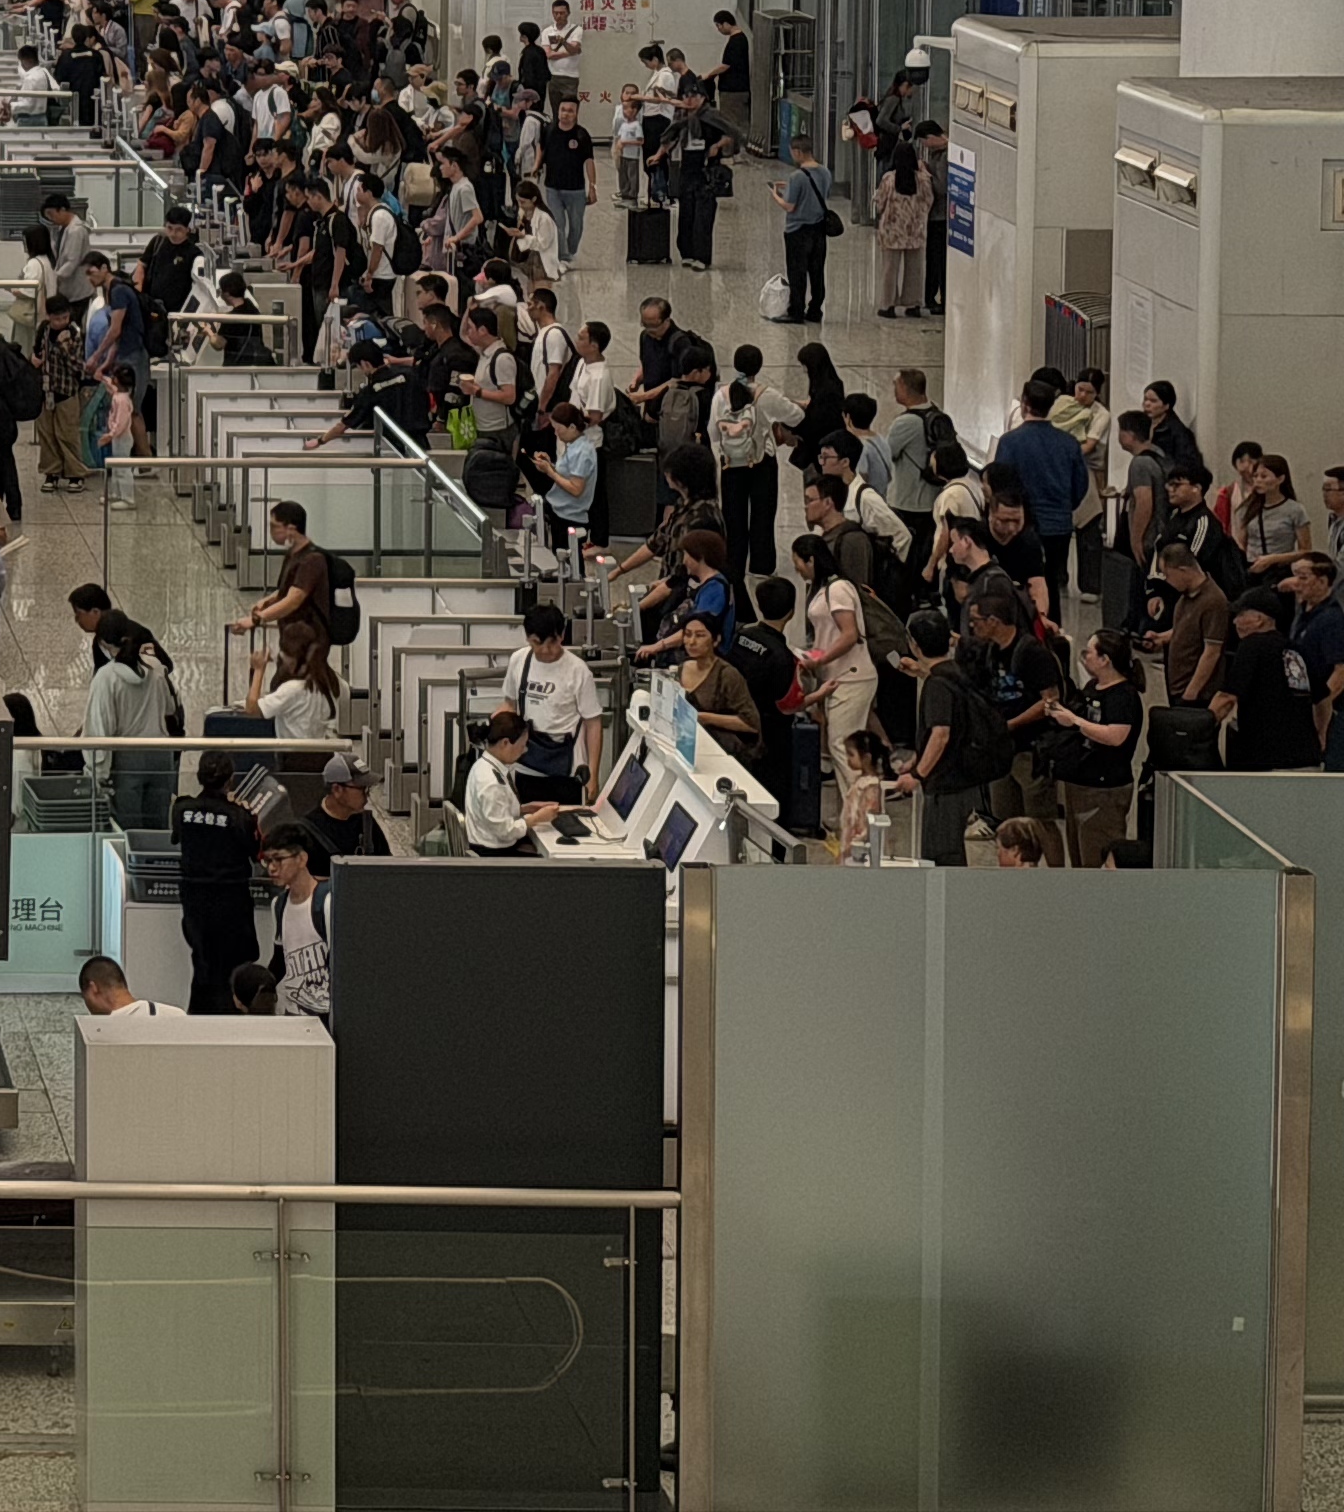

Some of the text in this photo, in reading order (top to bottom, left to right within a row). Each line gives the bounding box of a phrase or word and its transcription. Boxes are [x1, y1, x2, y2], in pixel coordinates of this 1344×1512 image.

[578, 91, 624, 104] 灭火
[11, 897, 64, 922] 理台
[10, 923, 23, 931] NG
